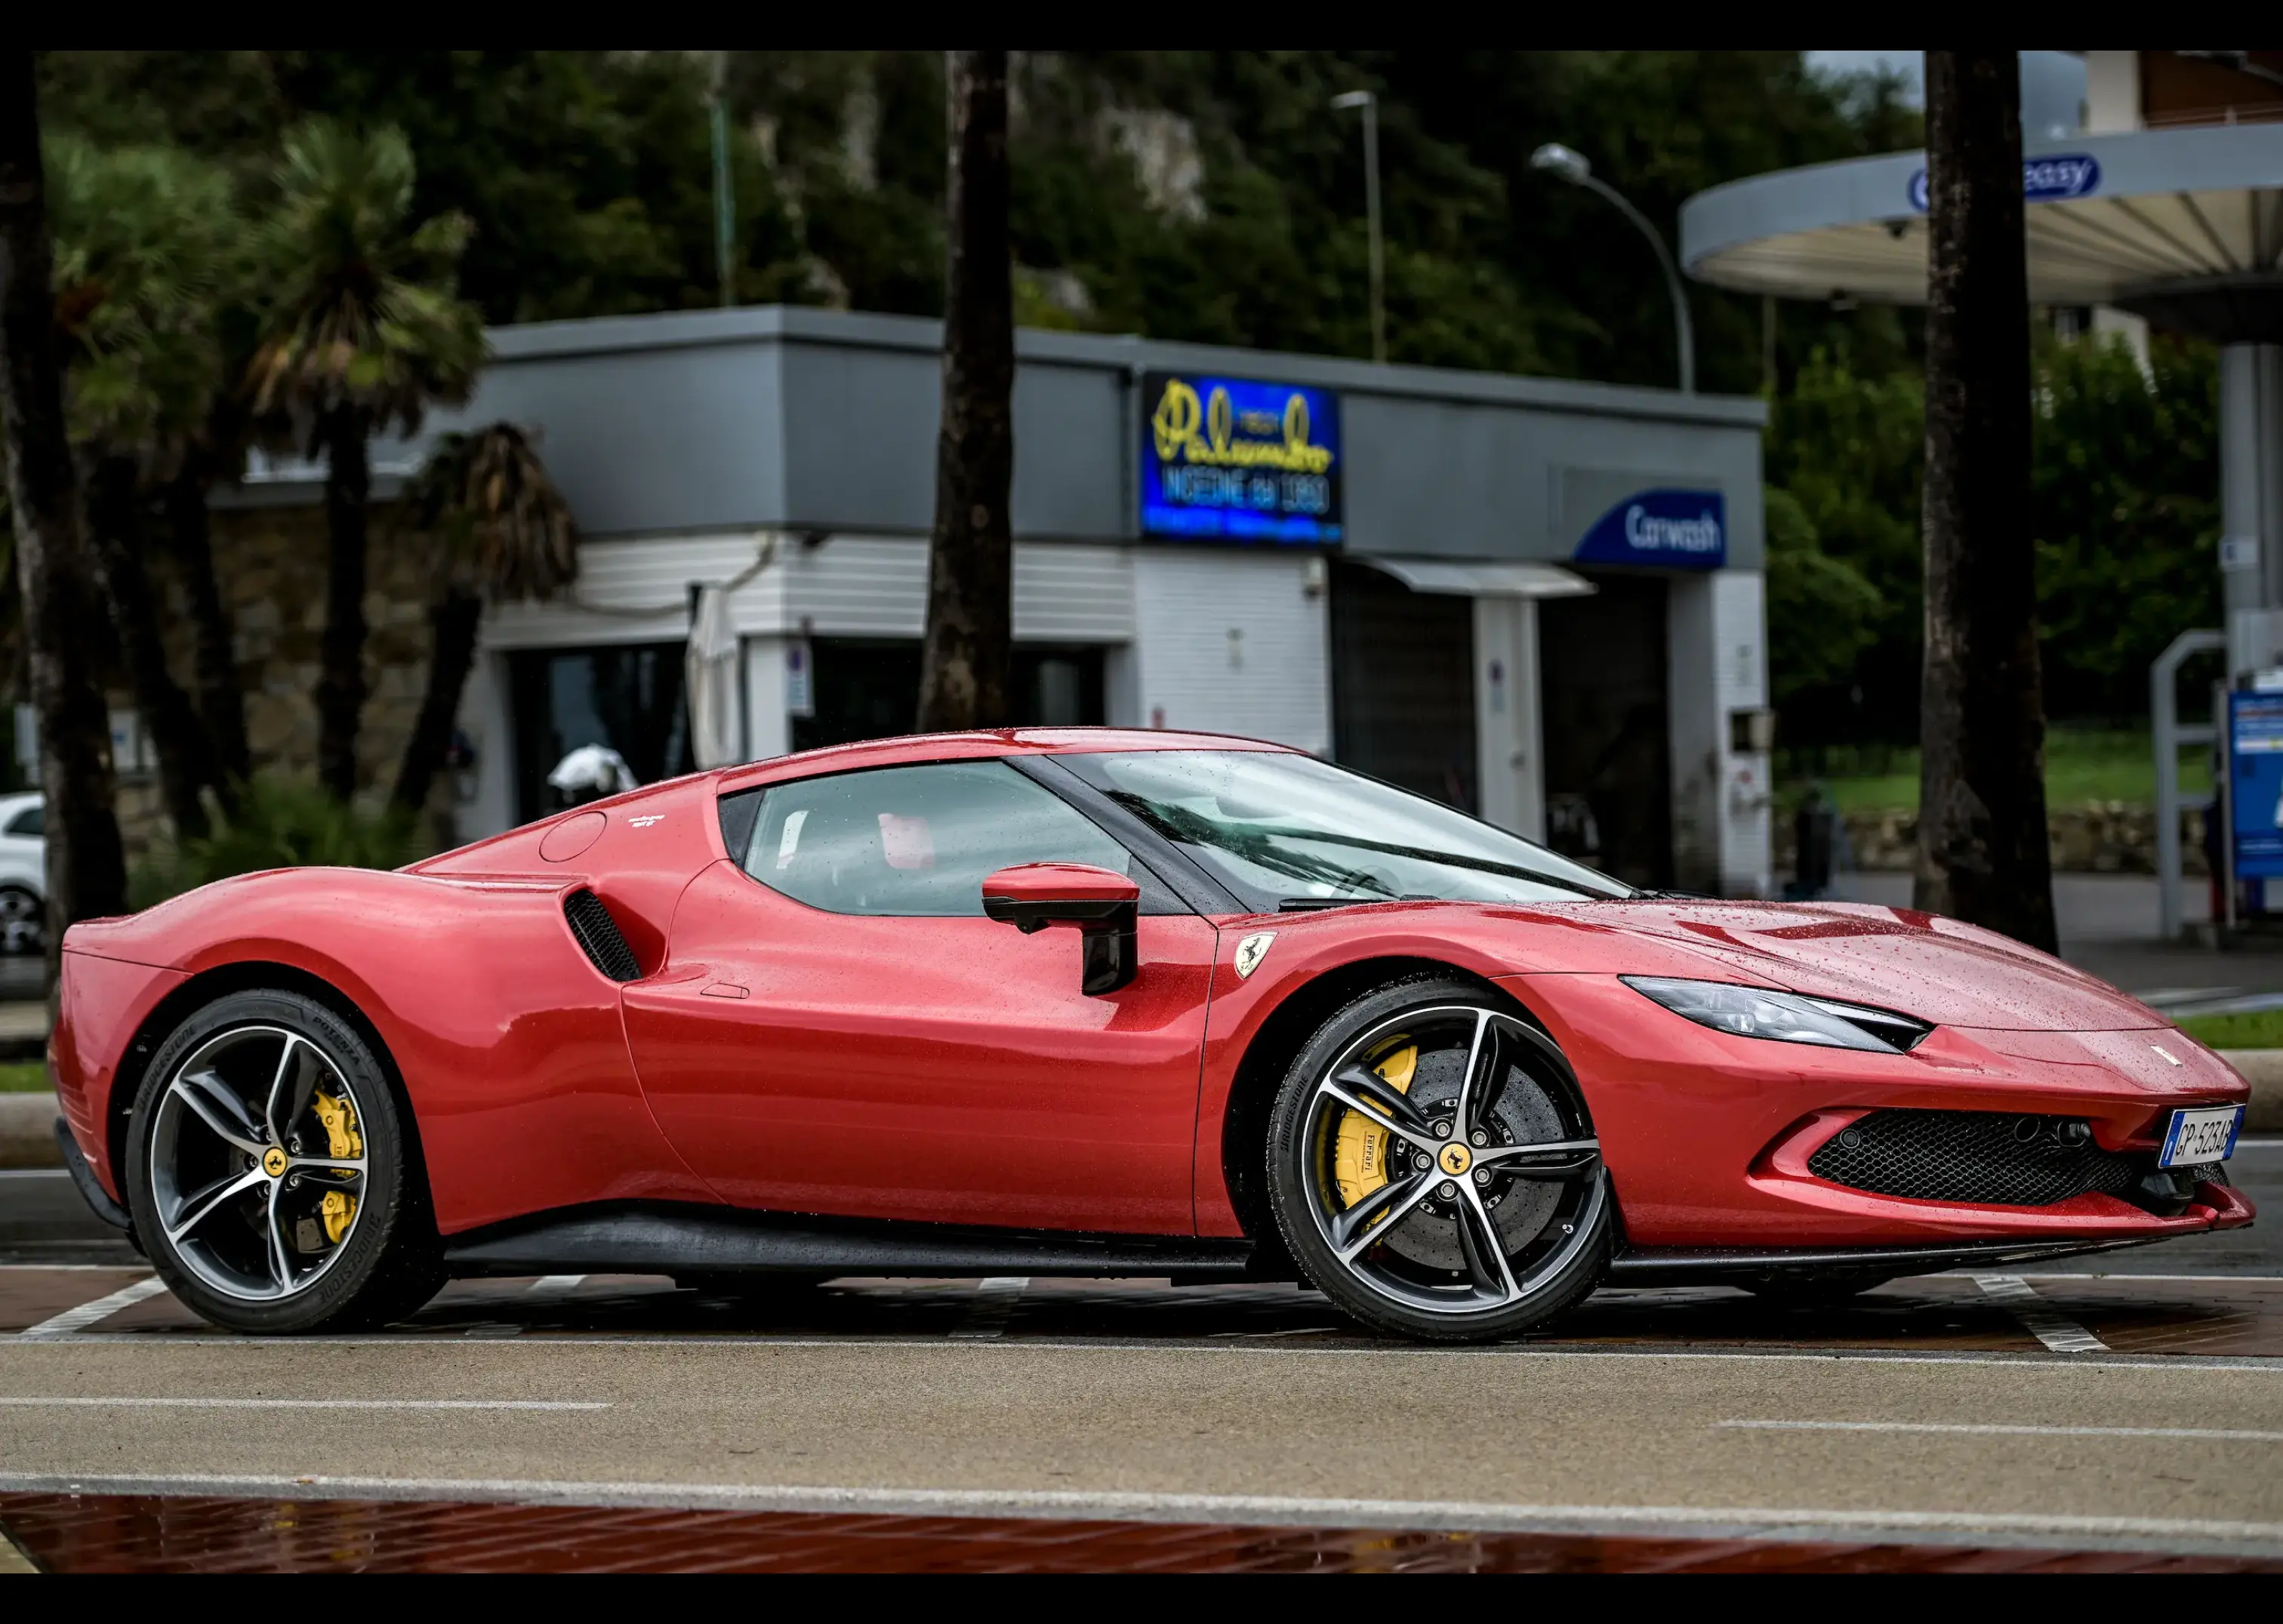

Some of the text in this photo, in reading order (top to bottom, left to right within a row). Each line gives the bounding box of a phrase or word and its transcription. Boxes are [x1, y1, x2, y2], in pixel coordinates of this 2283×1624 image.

[1625, 504, 1721, 551] Carwash
[137, 1024, 197, 1114] BRIDGESTONE
[1280, 1074, 1309, 1152] BRIDGESTONE
[1365, 1135, 1375, 1170] Ferrari
[319, 1212, 380, 1303] BRIDGESTONE
